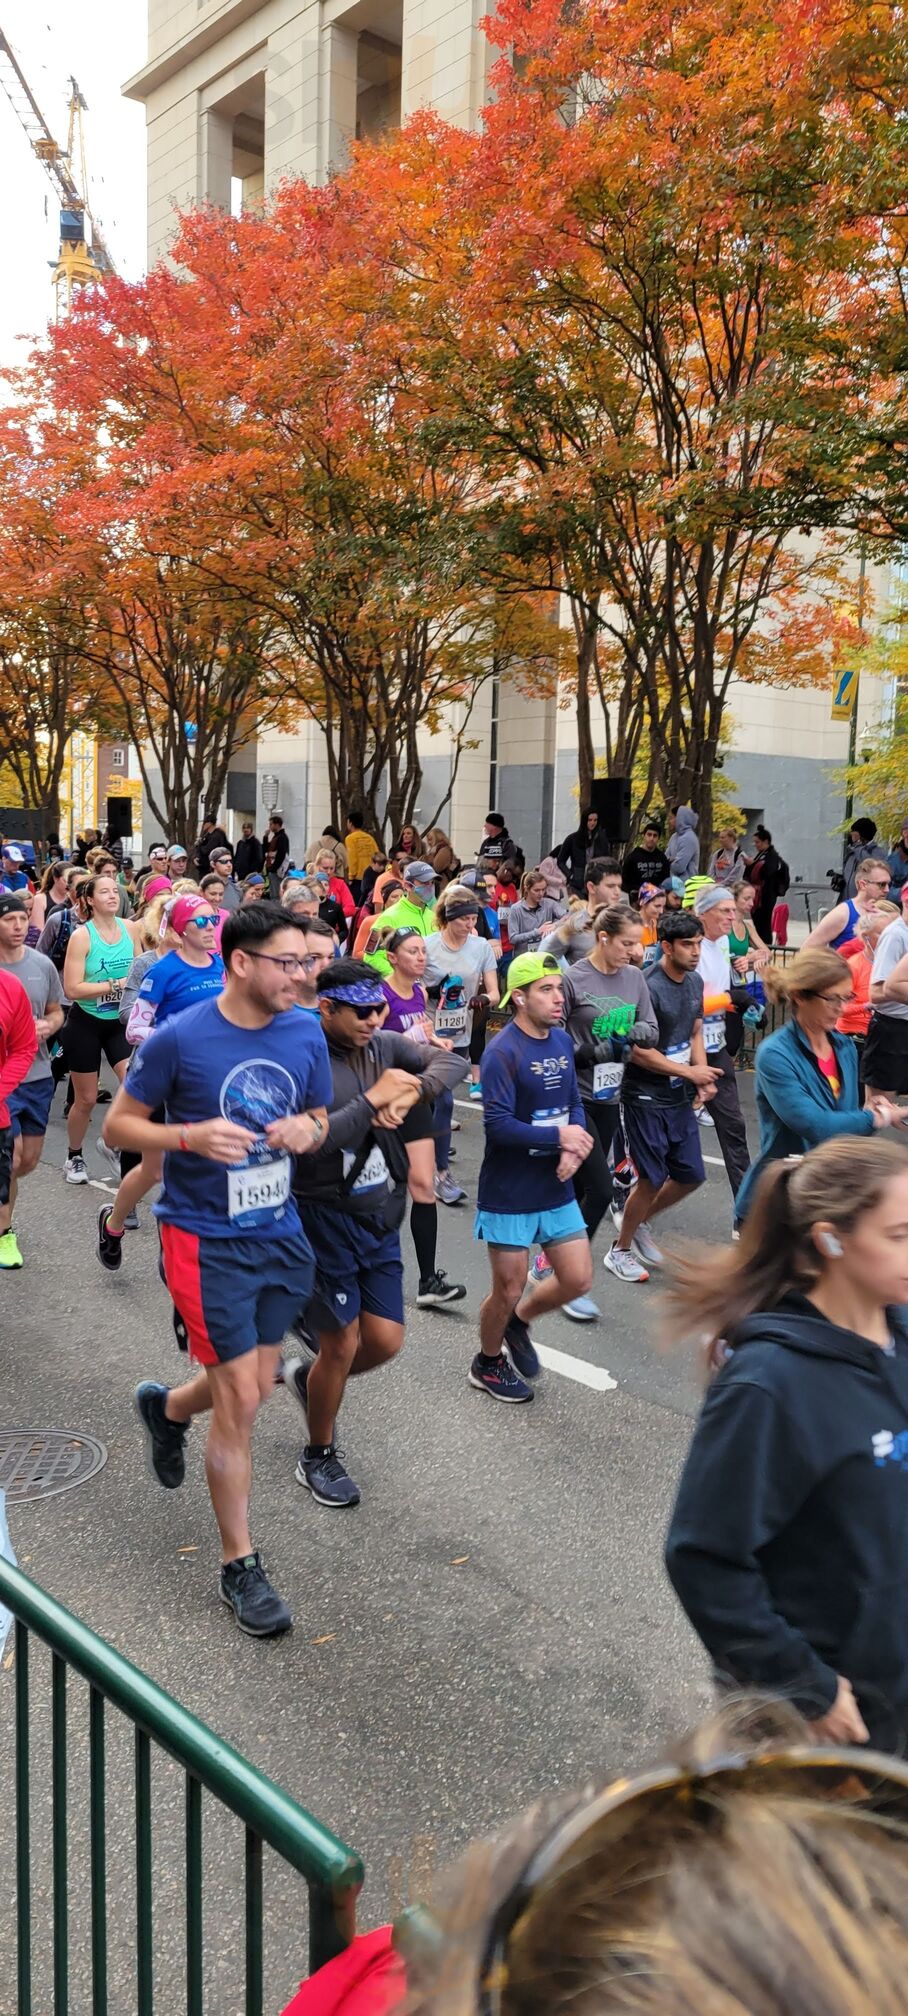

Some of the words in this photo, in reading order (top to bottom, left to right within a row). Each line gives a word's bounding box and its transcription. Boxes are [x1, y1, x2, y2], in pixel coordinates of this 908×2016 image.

[834, 671, 854, 706] Z
[438, 1016, 465, 1027] 11281
[543, 1058, 560, 1076] 50
